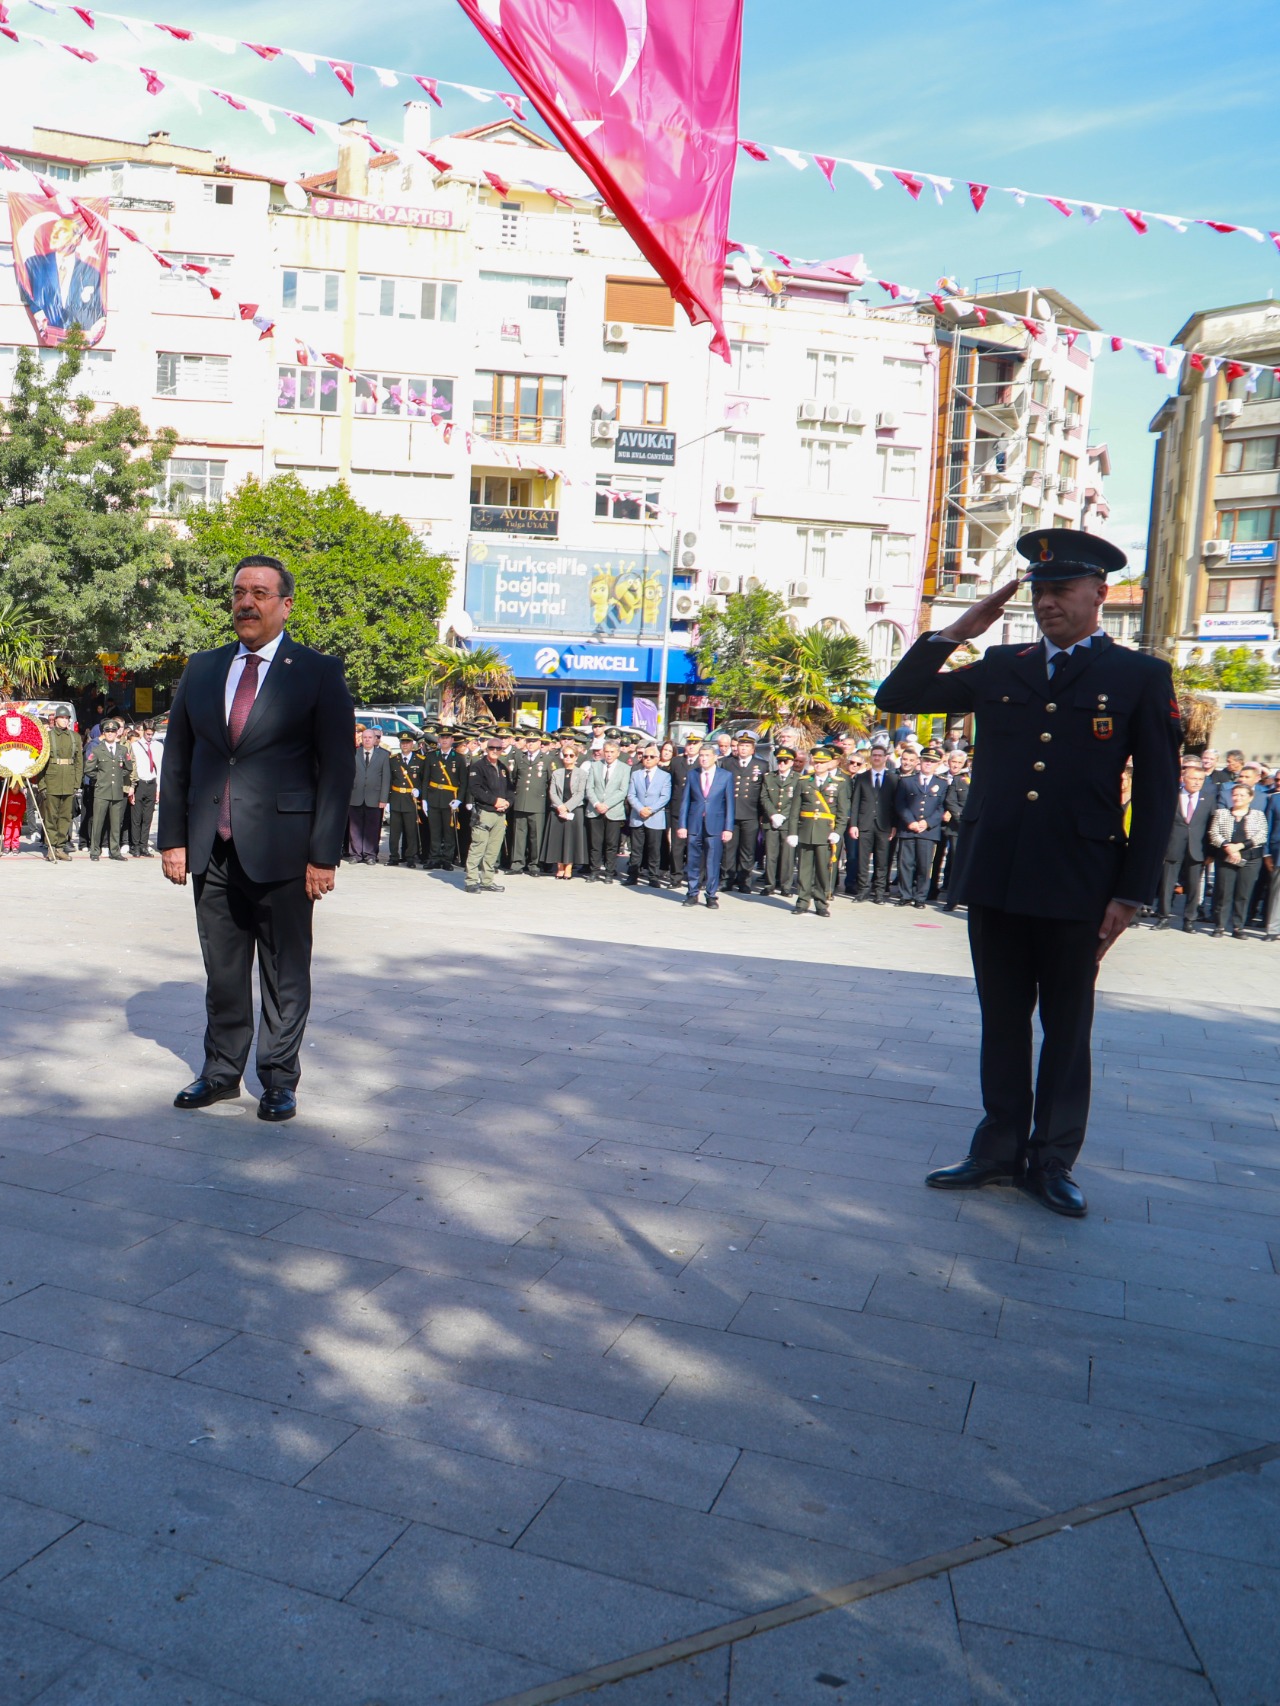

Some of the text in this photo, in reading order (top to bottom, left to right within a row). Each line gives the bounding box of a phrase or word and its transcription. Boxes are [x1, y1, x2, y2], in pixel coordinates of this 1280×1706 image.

[333, 201, 450, 225] EMEK PARTİSİ
[619, 431, 675, 449] AVUKAT
[500, 508, 557, 522] AVUKAT
[496, 573, 560, 597] bağlan
[494, 594, 567, 618] hayata!
[564, 654, 640, 672] TURKCELL
